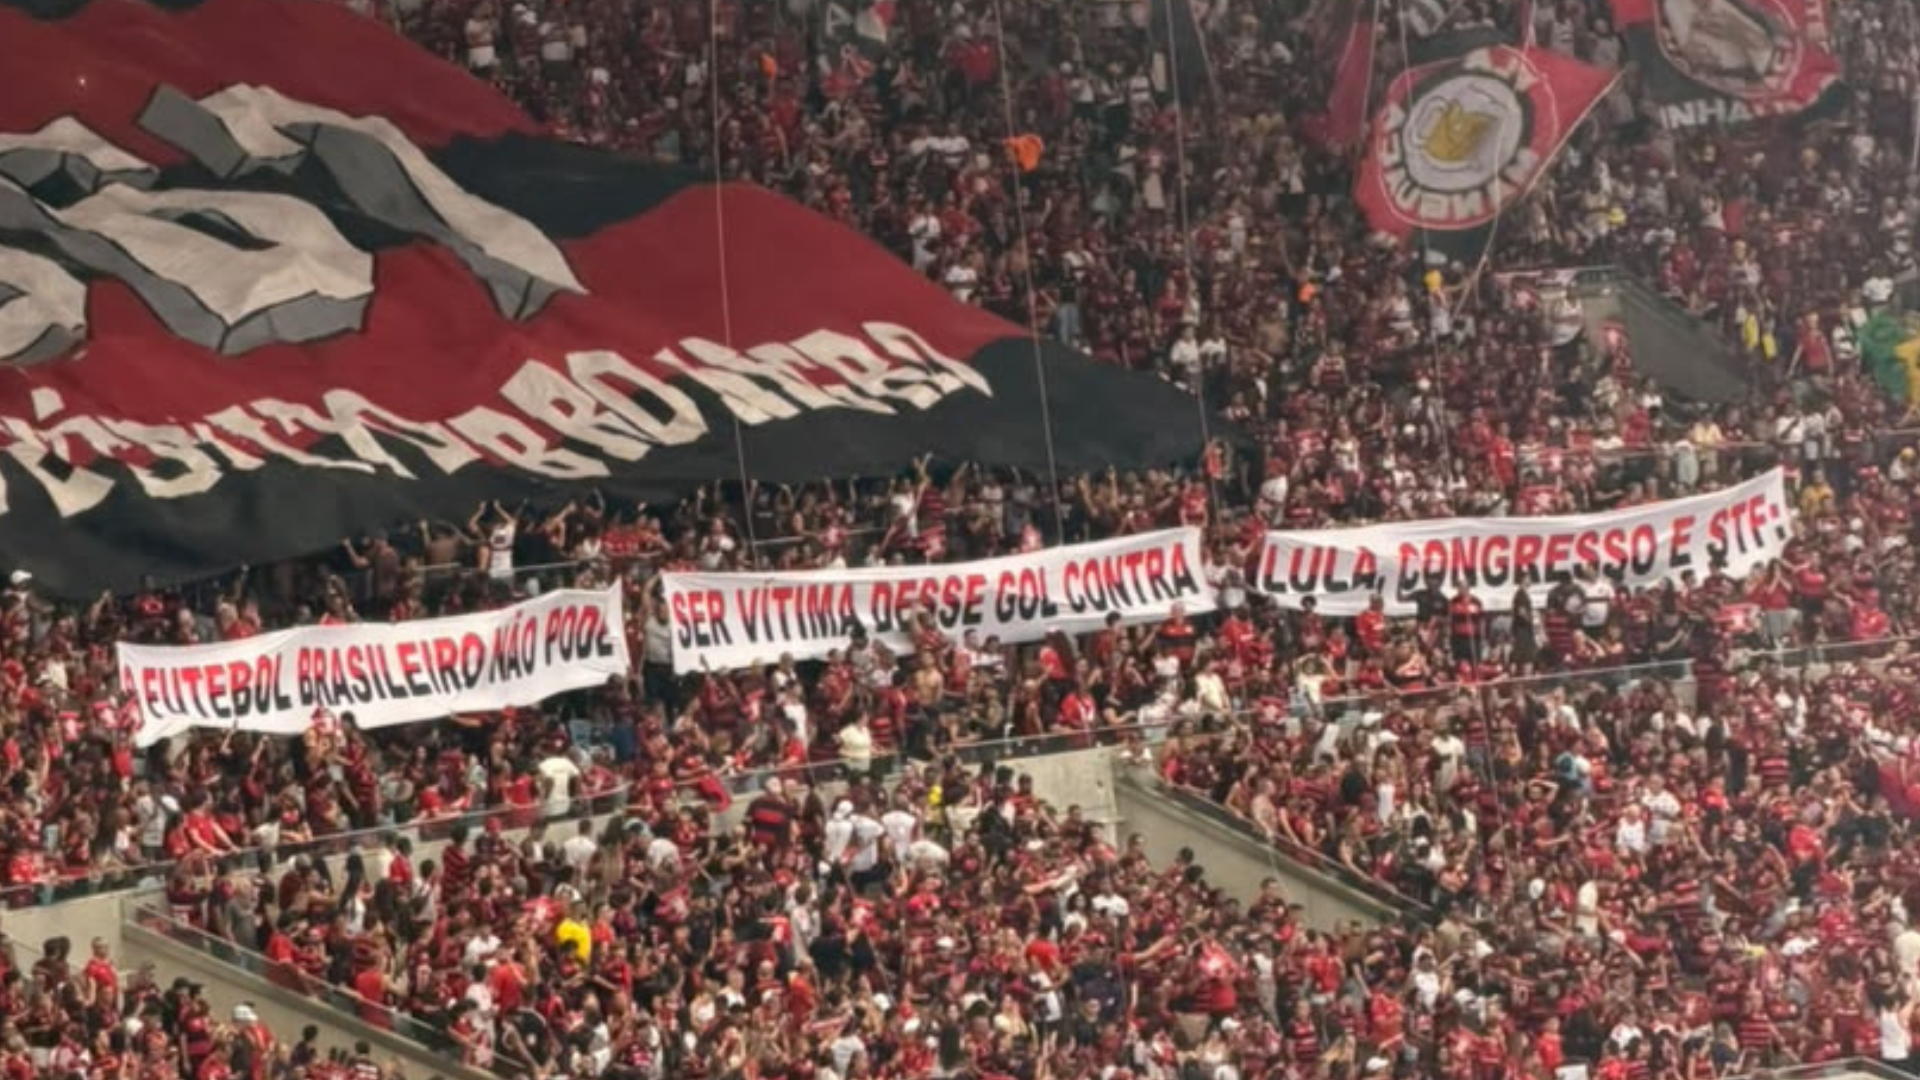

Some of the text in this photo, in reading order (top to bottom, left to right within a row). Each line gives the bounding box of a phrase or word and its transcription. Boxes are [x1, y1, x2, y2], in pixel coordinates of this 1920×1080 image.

[672, 543, 1199, 649] SER VÍTIMA DESSE GOL CONTRA
[1263, 495, 1785, 593] LULA, CONGRESSO E STF:
[142, 653, 292, 719] FUTEBOL
[299, 632, 486, 707] BRASILEIRO
[488, 609, 537, 683] NÃO
[545, 605, 613, 666] PODE
